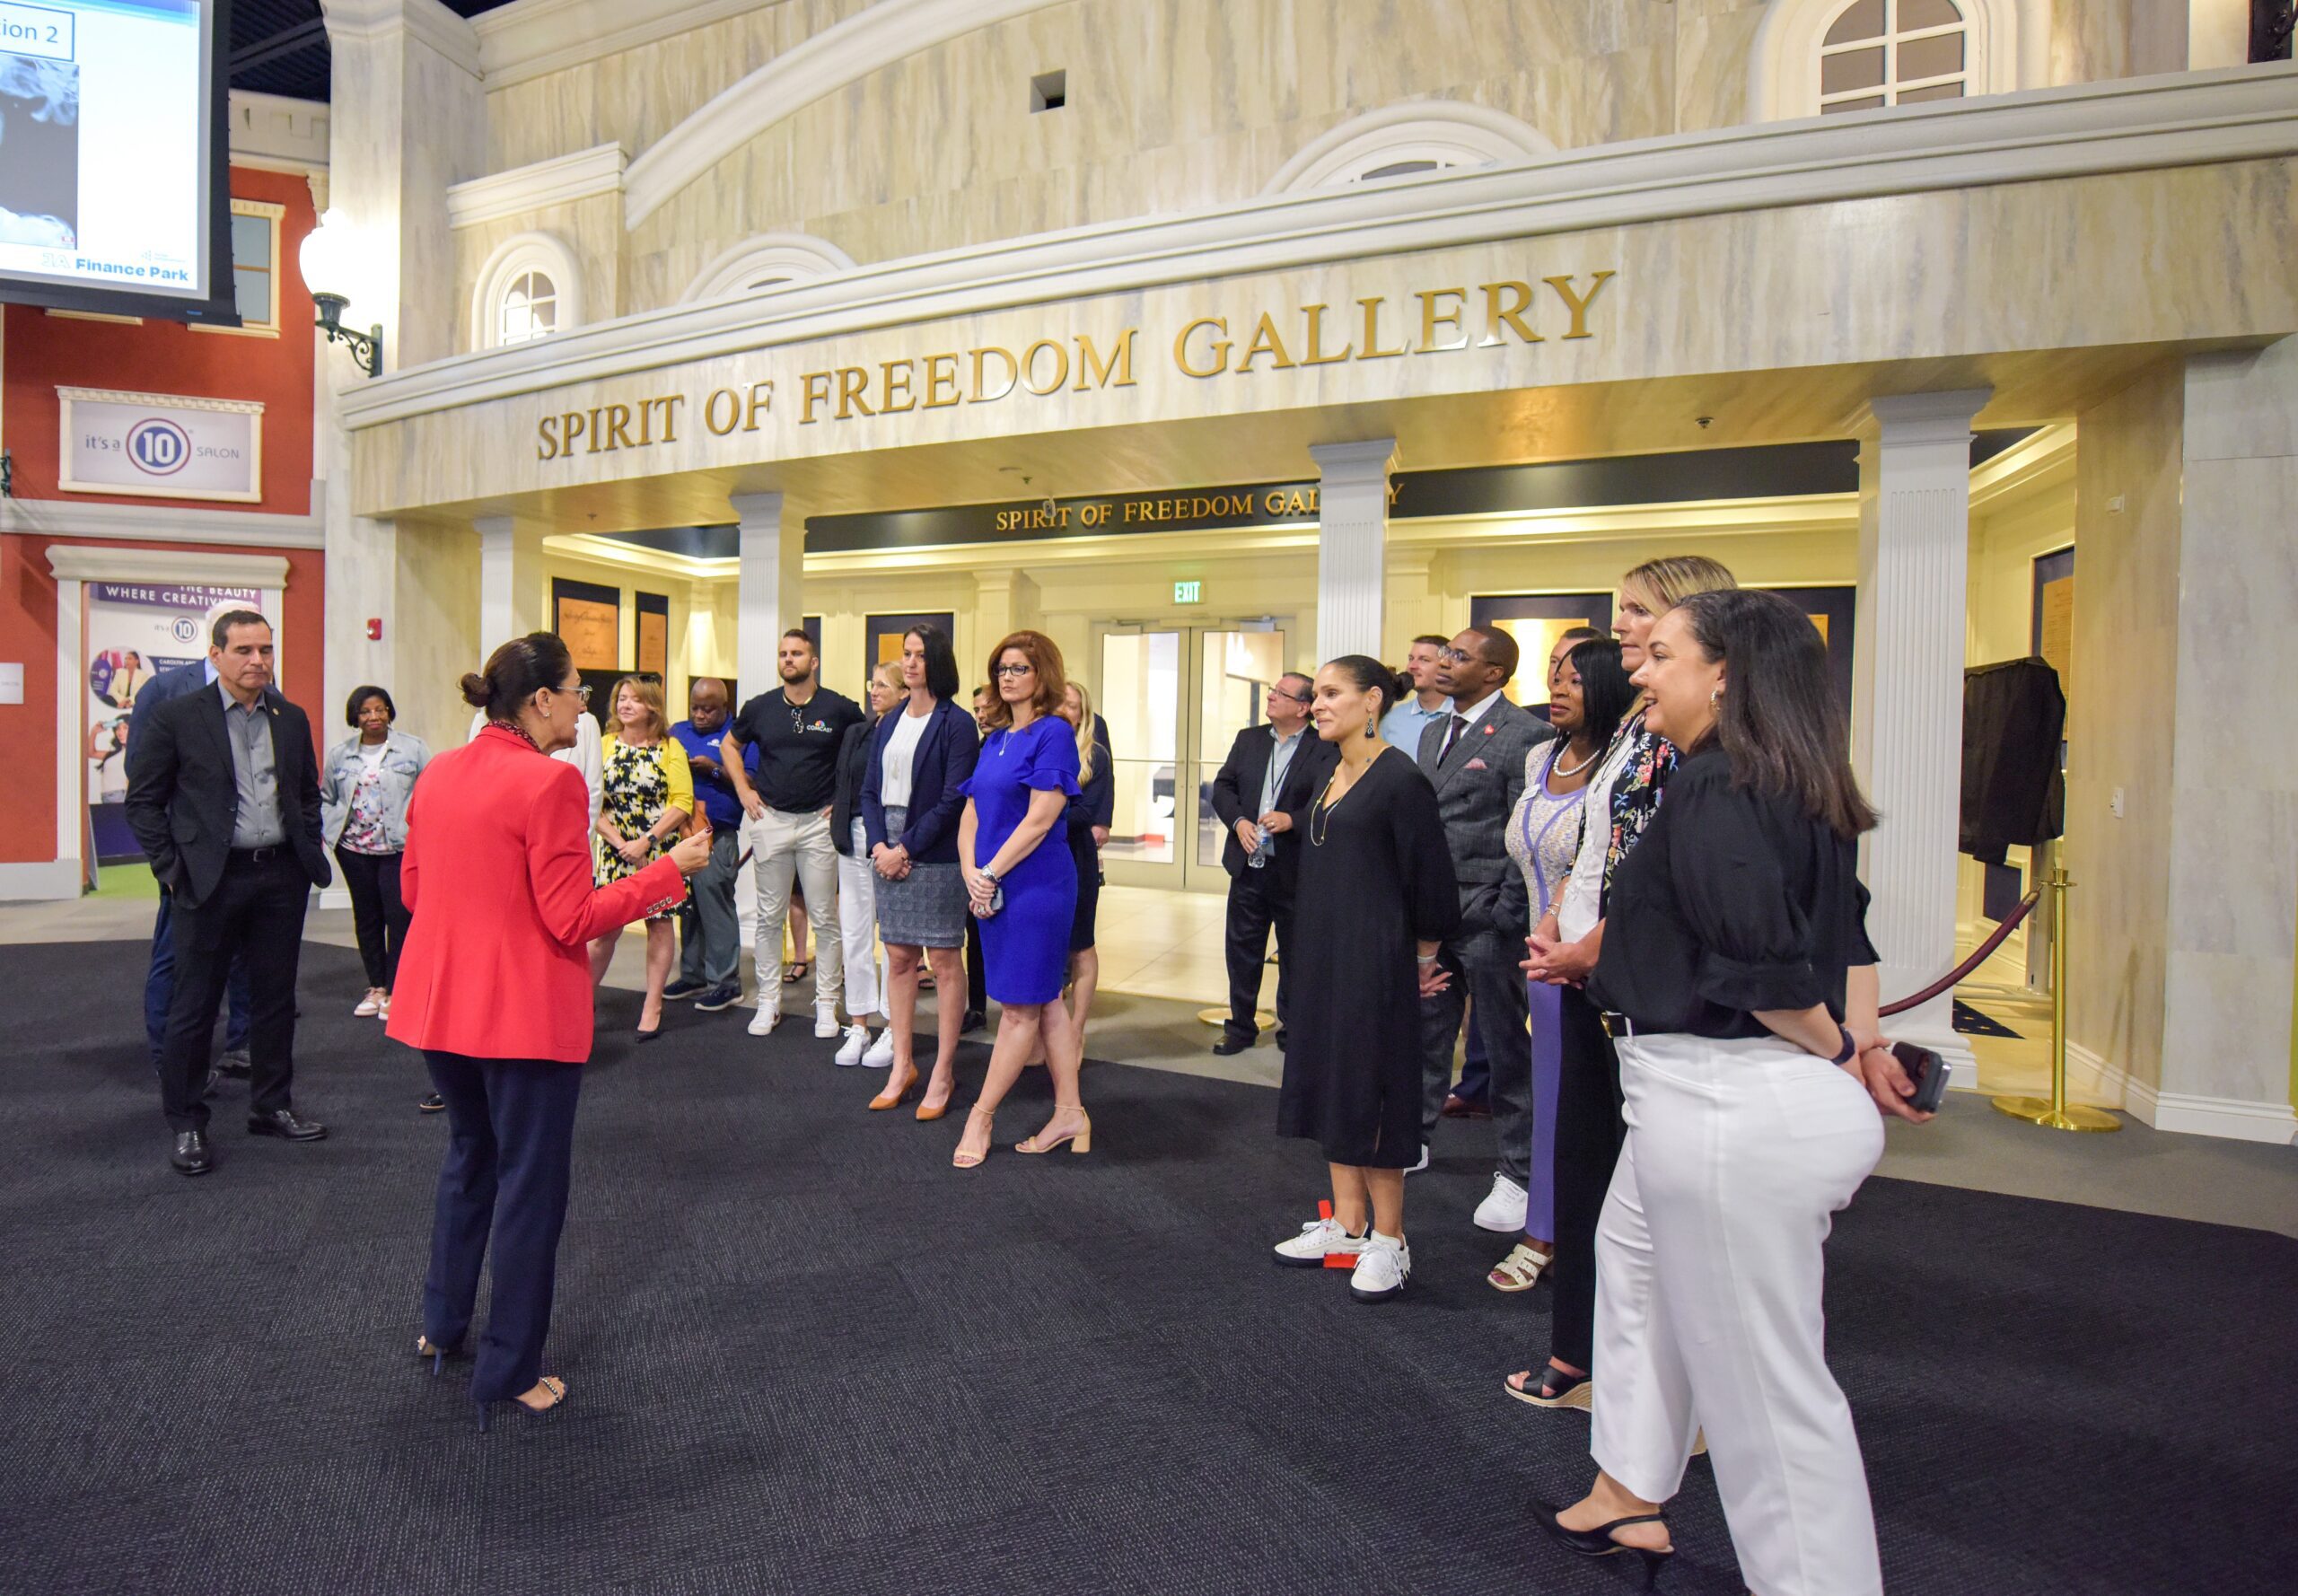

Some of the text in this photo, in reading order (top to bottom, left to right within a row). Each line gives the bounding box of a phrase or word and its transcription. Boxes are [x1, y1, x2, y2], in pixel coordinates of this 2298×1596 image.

[0, 19, 58, 44] ion 2
[75, 258, 145, 276] Finance
[149, 266, 189, 282] Park
[538, 269, 1616, 460] SPIRIT OF FREEDOM GALLERY
[85, 431, 240, 465] it's a 10 SALON
[996, 483, 1406, 531] SPIRIT OF FREEDOM GALY
[105, 585, 156, 601] WHERE
[209, 587, 257, 599] BEAUTY
[1174, 581, 1201, 604] EXIT
